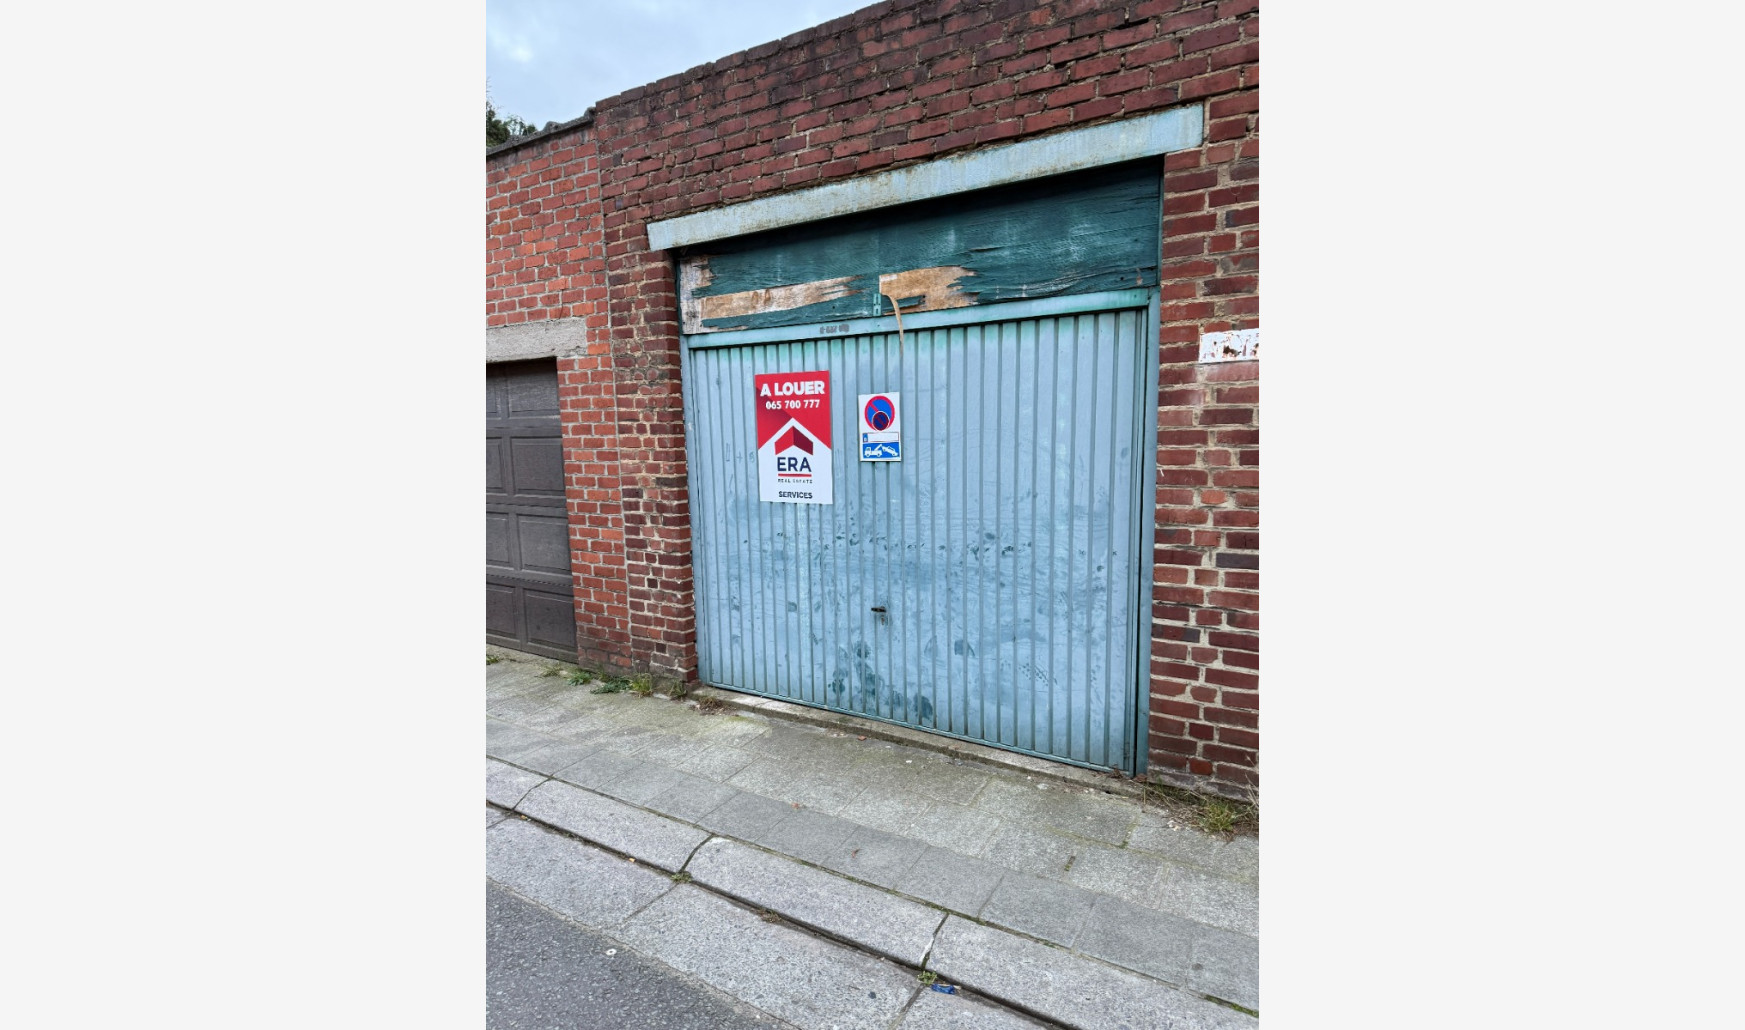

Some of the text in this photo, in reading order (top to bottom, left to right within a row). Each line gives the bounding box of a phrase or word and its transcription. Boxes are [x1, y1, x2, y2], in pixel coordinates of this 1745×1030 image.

[760, 381, 825, 396] A LOUER
[765, 399, 820, 409] 065 700 777
[777, 457, 812, 472] ERA
[778, 490, 813, 499] SERVICES
